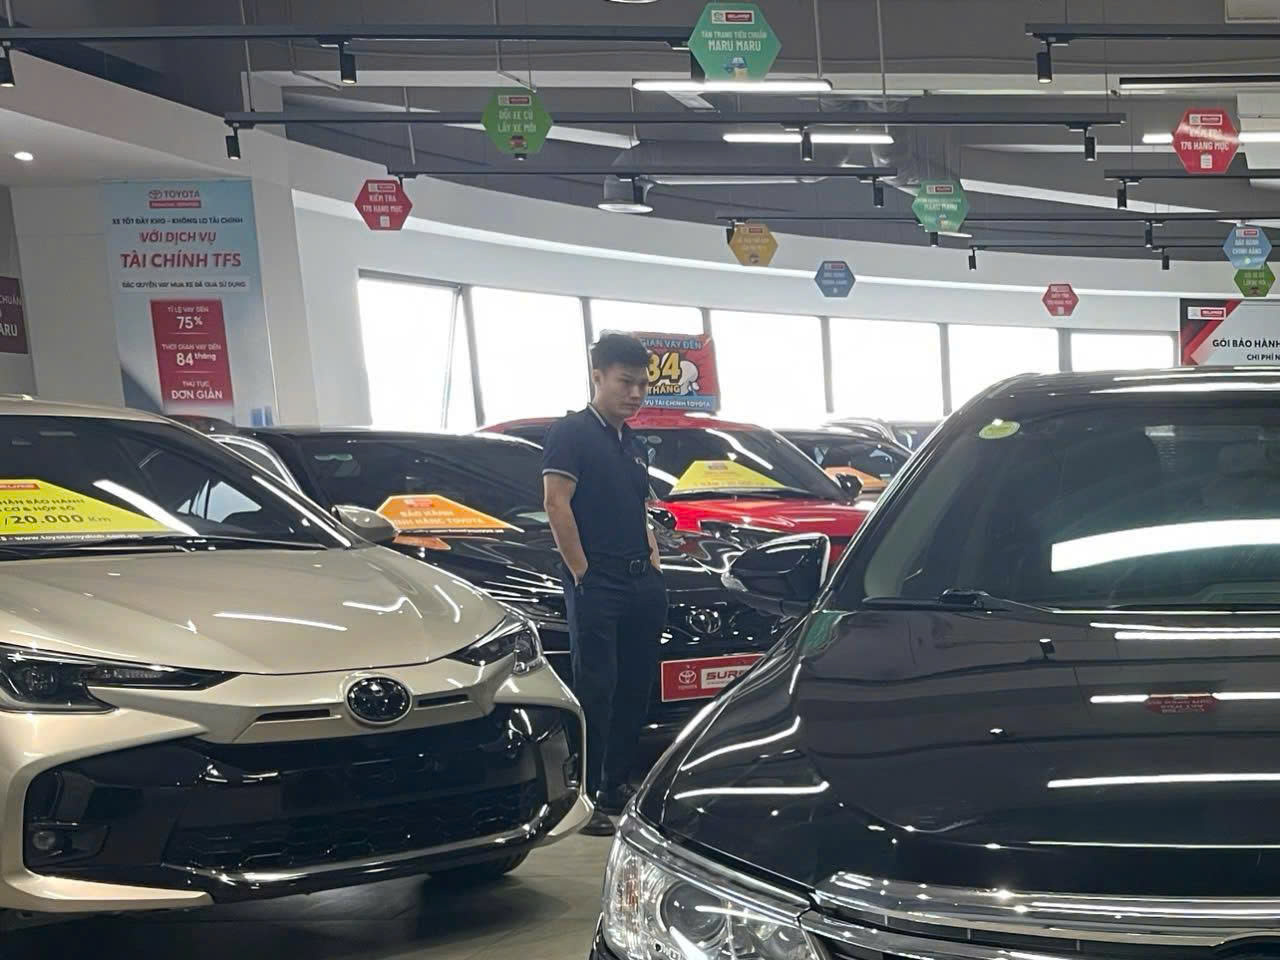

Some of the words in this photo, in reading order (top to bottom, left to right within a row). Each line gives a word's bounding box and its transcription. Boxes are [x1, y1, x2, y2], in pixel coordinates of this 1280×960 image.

[708, 40, 733, 52] MARU
[736, 40, 761, 52] MARU
[163, 189, 201, 199] TOYOTA
[140, 228, 163, 243] VỚI
[165, 231, 196, 246] DỊCH
[199, 231, 217, 246] VỤ
[120, 250, 146, 268] TÀI
[151, 250, 208, 268] CHÍNH
[212, 253, 242, 267] TFS
[176, 315, 203, 329] 75%
[664, 340, 681, 348] VAY
[1212, 337, 1231, 348] GÓI
[1232, 337, 1253, 348] BẢO
[176, 352, 194, 366] 84
[1246, 353, 1260, 361] CHI
[1261, 353, 1274, 361] PHÍ
[196, 387, 223, 400] GIẢN
